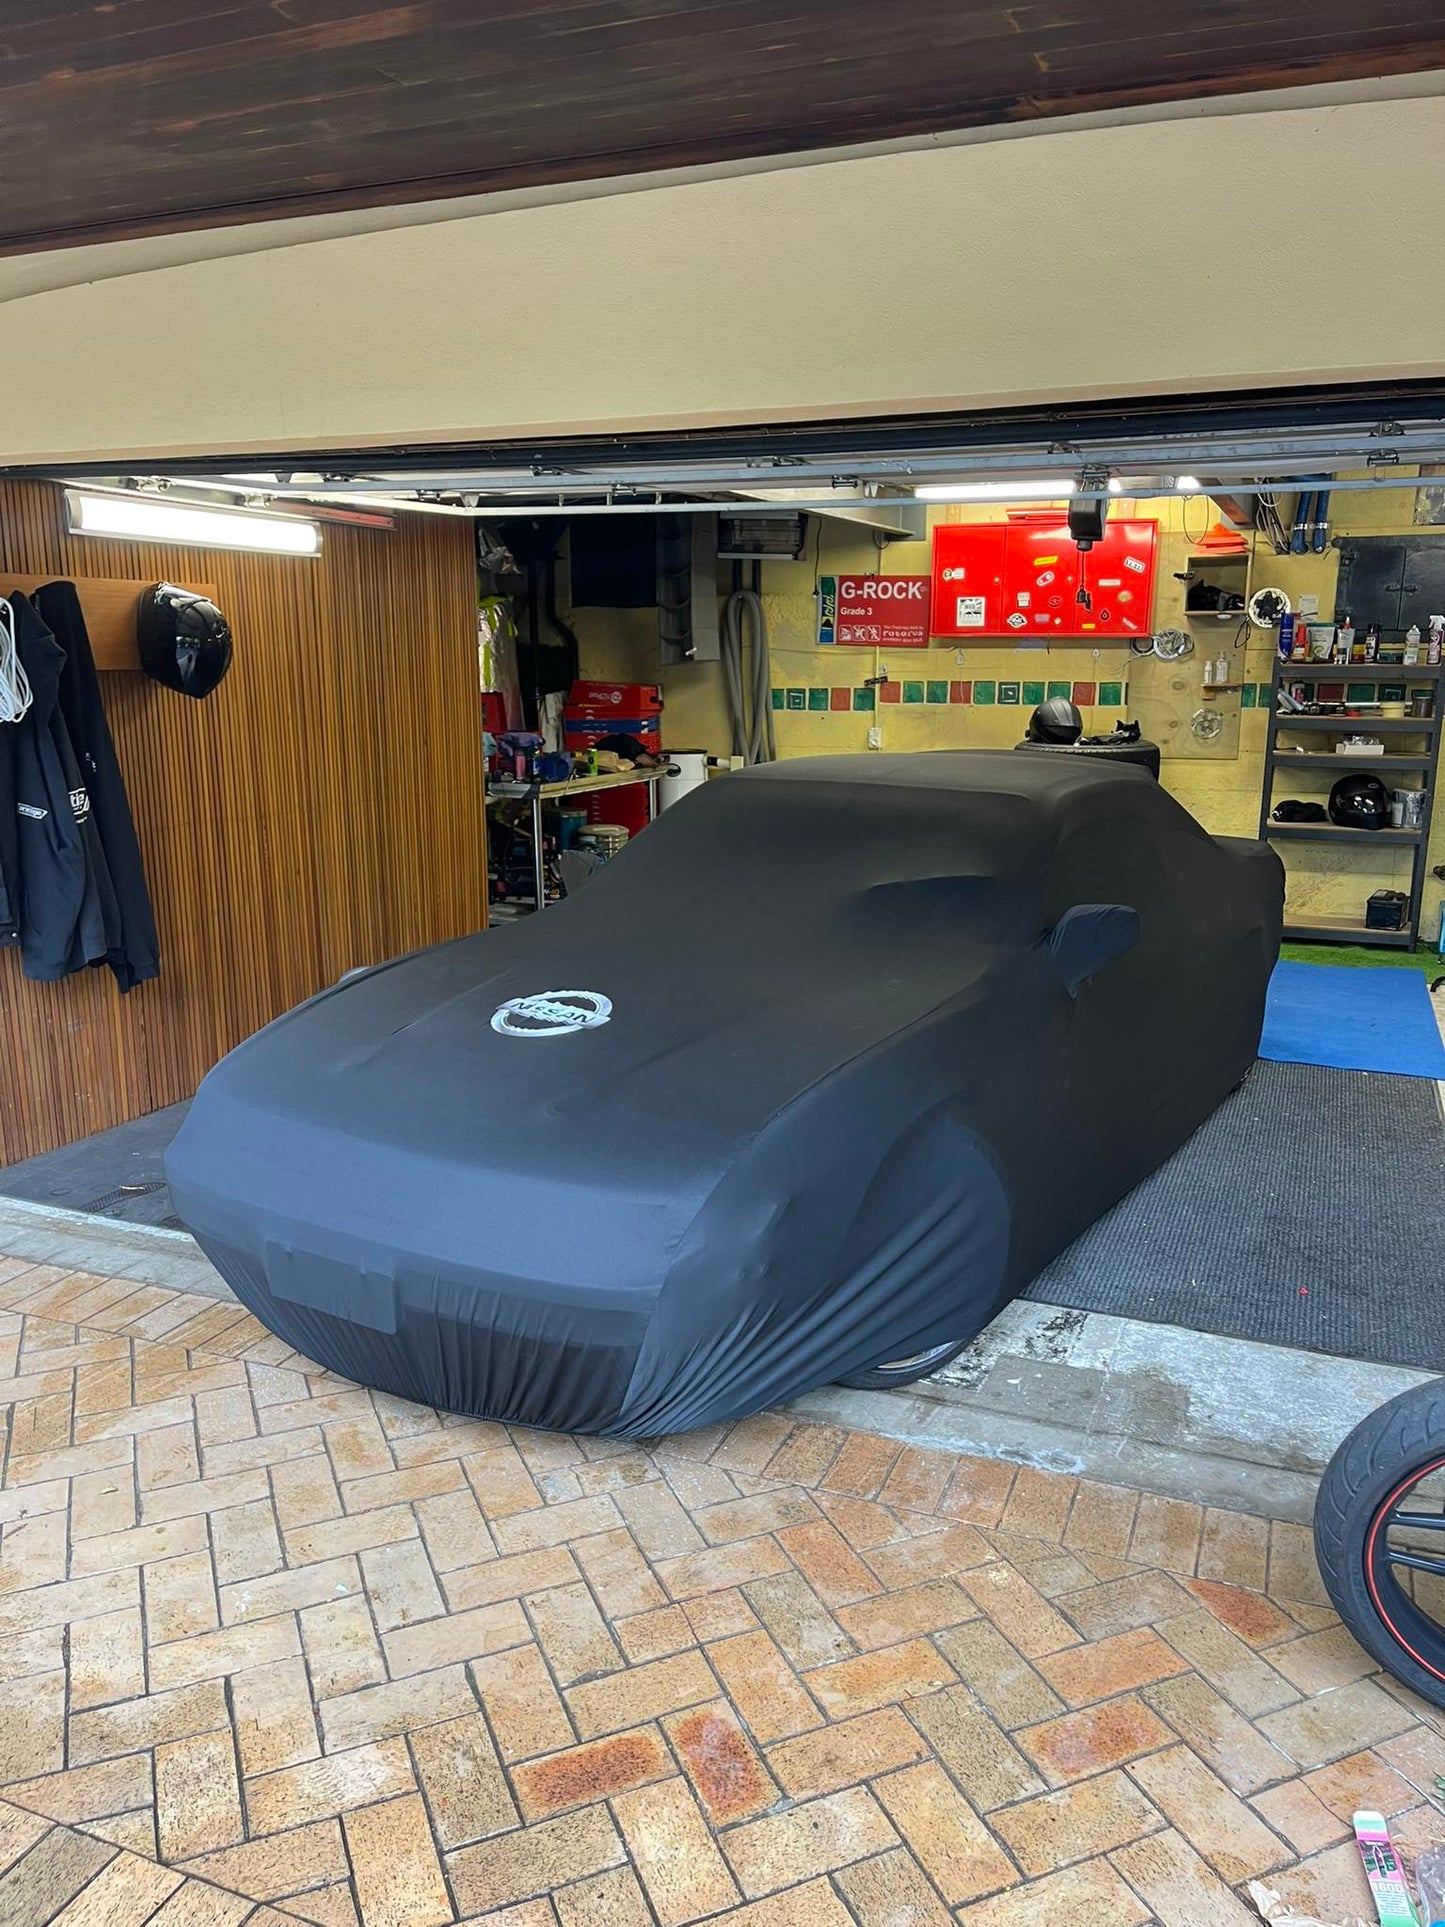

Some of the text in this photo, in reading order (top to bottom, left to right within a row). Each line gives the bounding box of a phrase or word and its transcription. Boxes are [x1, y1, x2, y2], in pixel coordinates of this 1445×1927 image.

[841, 581, 923, 599] G-ROCK
[840, 607, 873, 615] Grade 3
[512, 1001, 593, 1023] NISSAN
